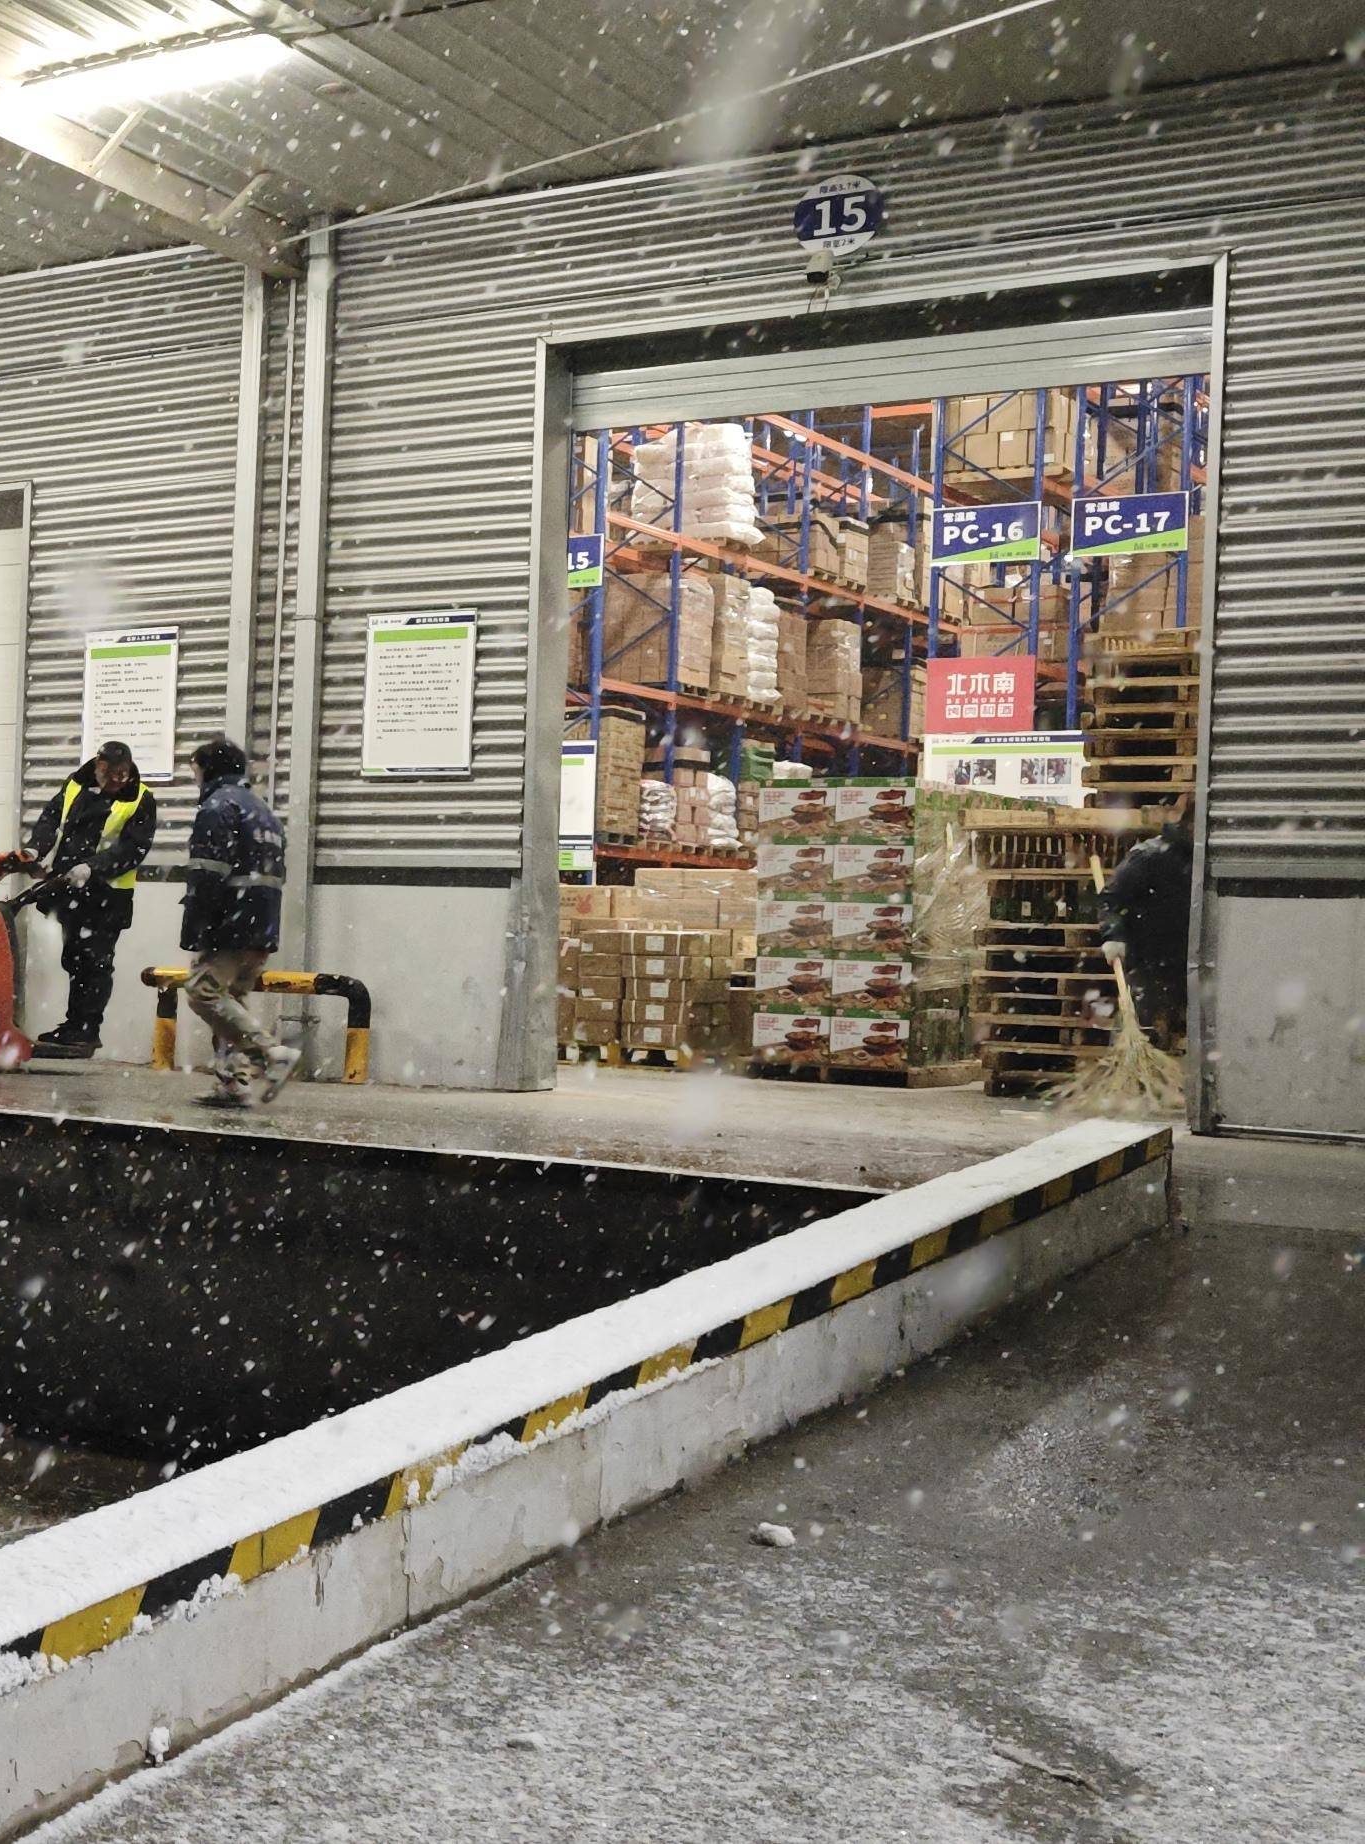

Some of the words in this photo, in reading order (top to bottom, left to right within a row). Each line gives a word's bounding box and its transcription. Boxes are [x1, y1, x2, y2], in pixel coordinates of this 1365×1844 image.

[813, 195, 867, 237] 15
[943, 522, 1024, 546] PC-16
[1085, 511, 1170, 536] PC-17
